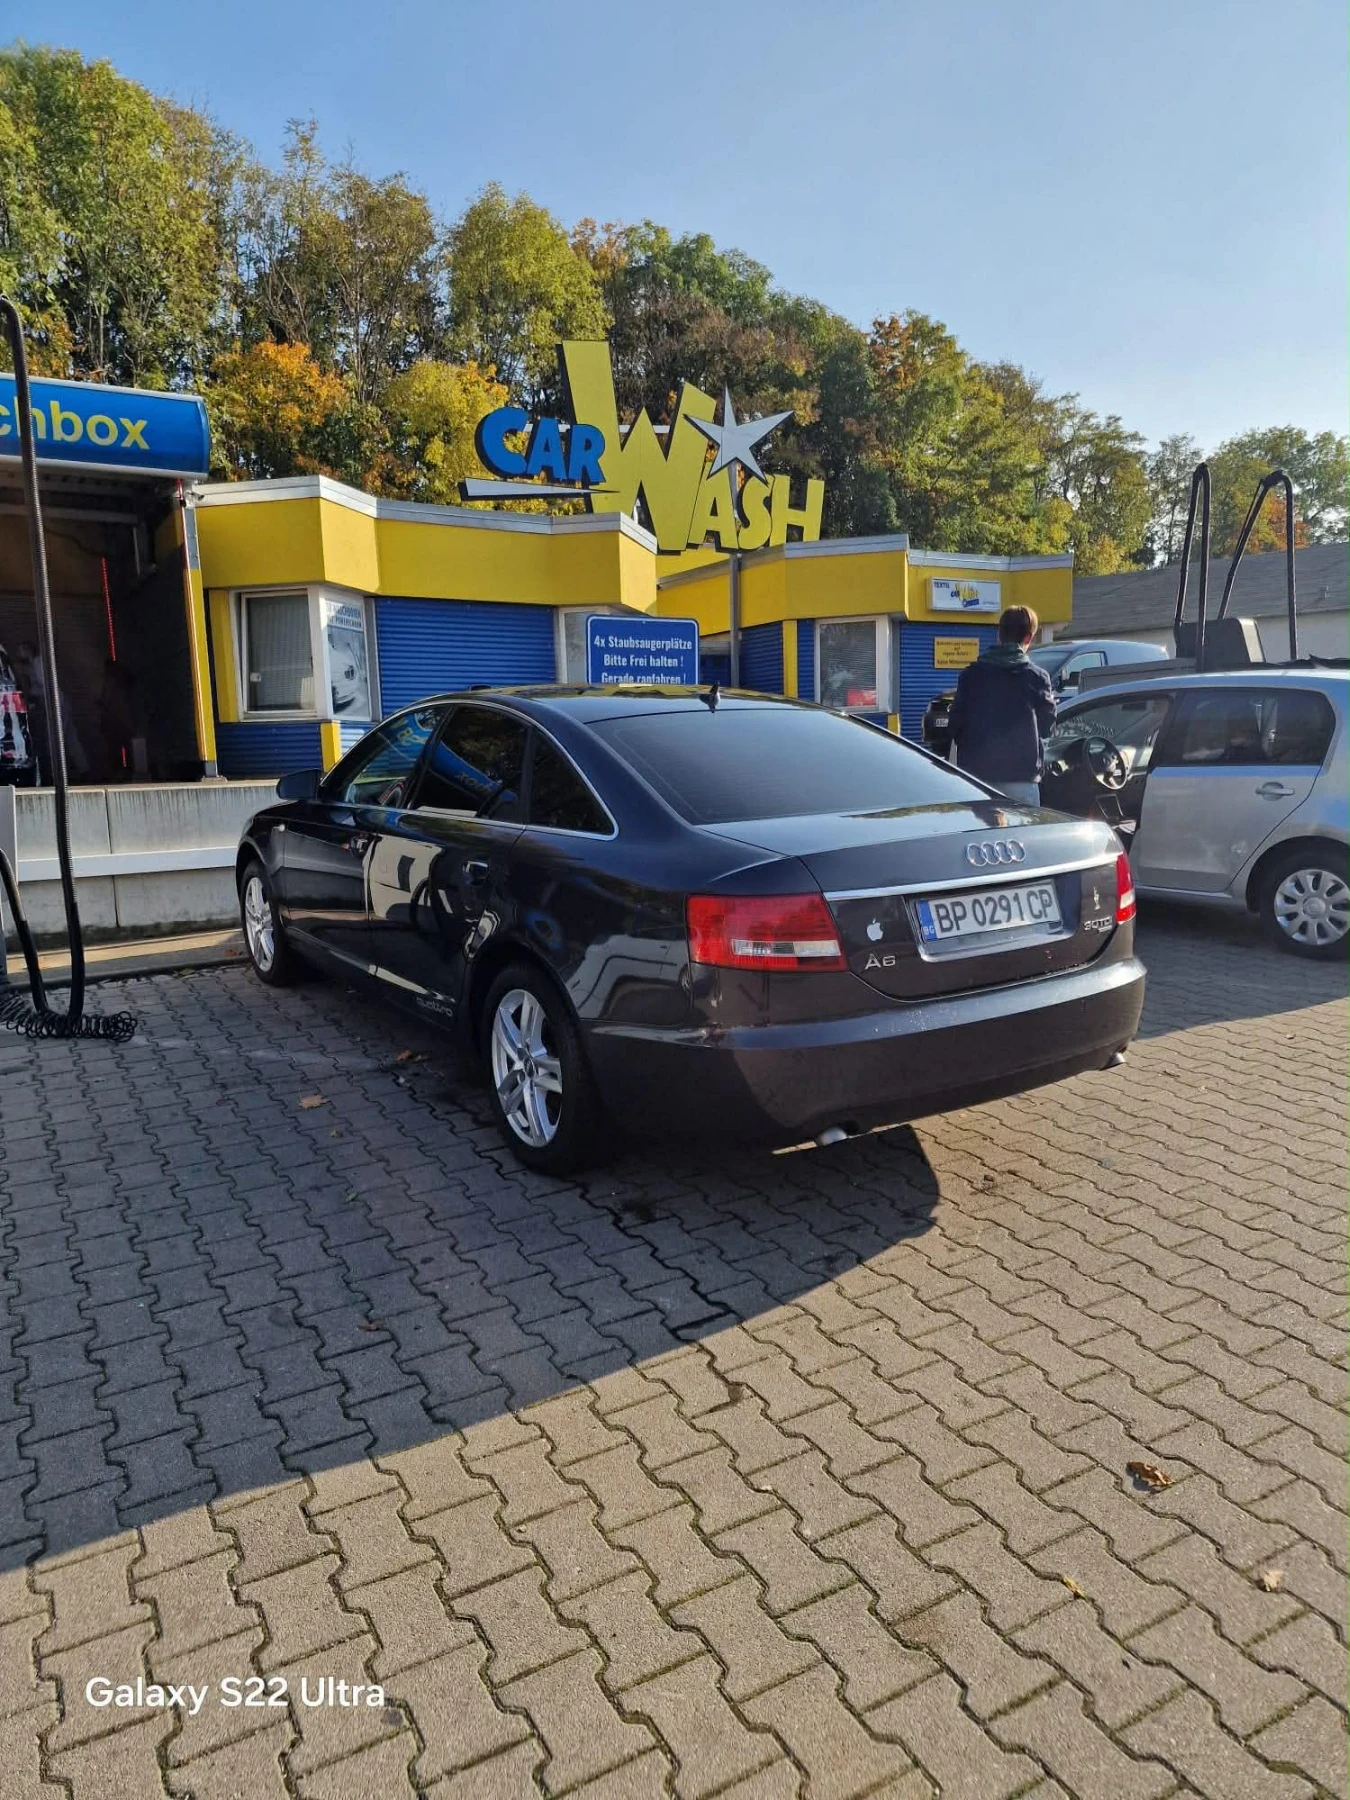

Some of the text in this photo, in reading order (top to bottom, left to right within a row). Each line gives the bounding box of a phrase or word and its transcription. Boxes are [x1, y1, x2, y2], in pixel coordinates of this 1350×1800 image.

[476, 340, 825, 552] CAR WASH
[594, 635, 693, 651] 4x Staubsaugerplätze
[604, 654, 628, 666] Bitte
[630, 656, 647, 667] Frei
[650, 656, 678, 667] halten
[601, 672, 634, 684] Gerade
[636, 674, 681, 684] ranfahren
[936, 889, 1053, 933] BP 0291 CP
[922, 926, 935, 936] BG
[864, 953, 897, 971] A6
